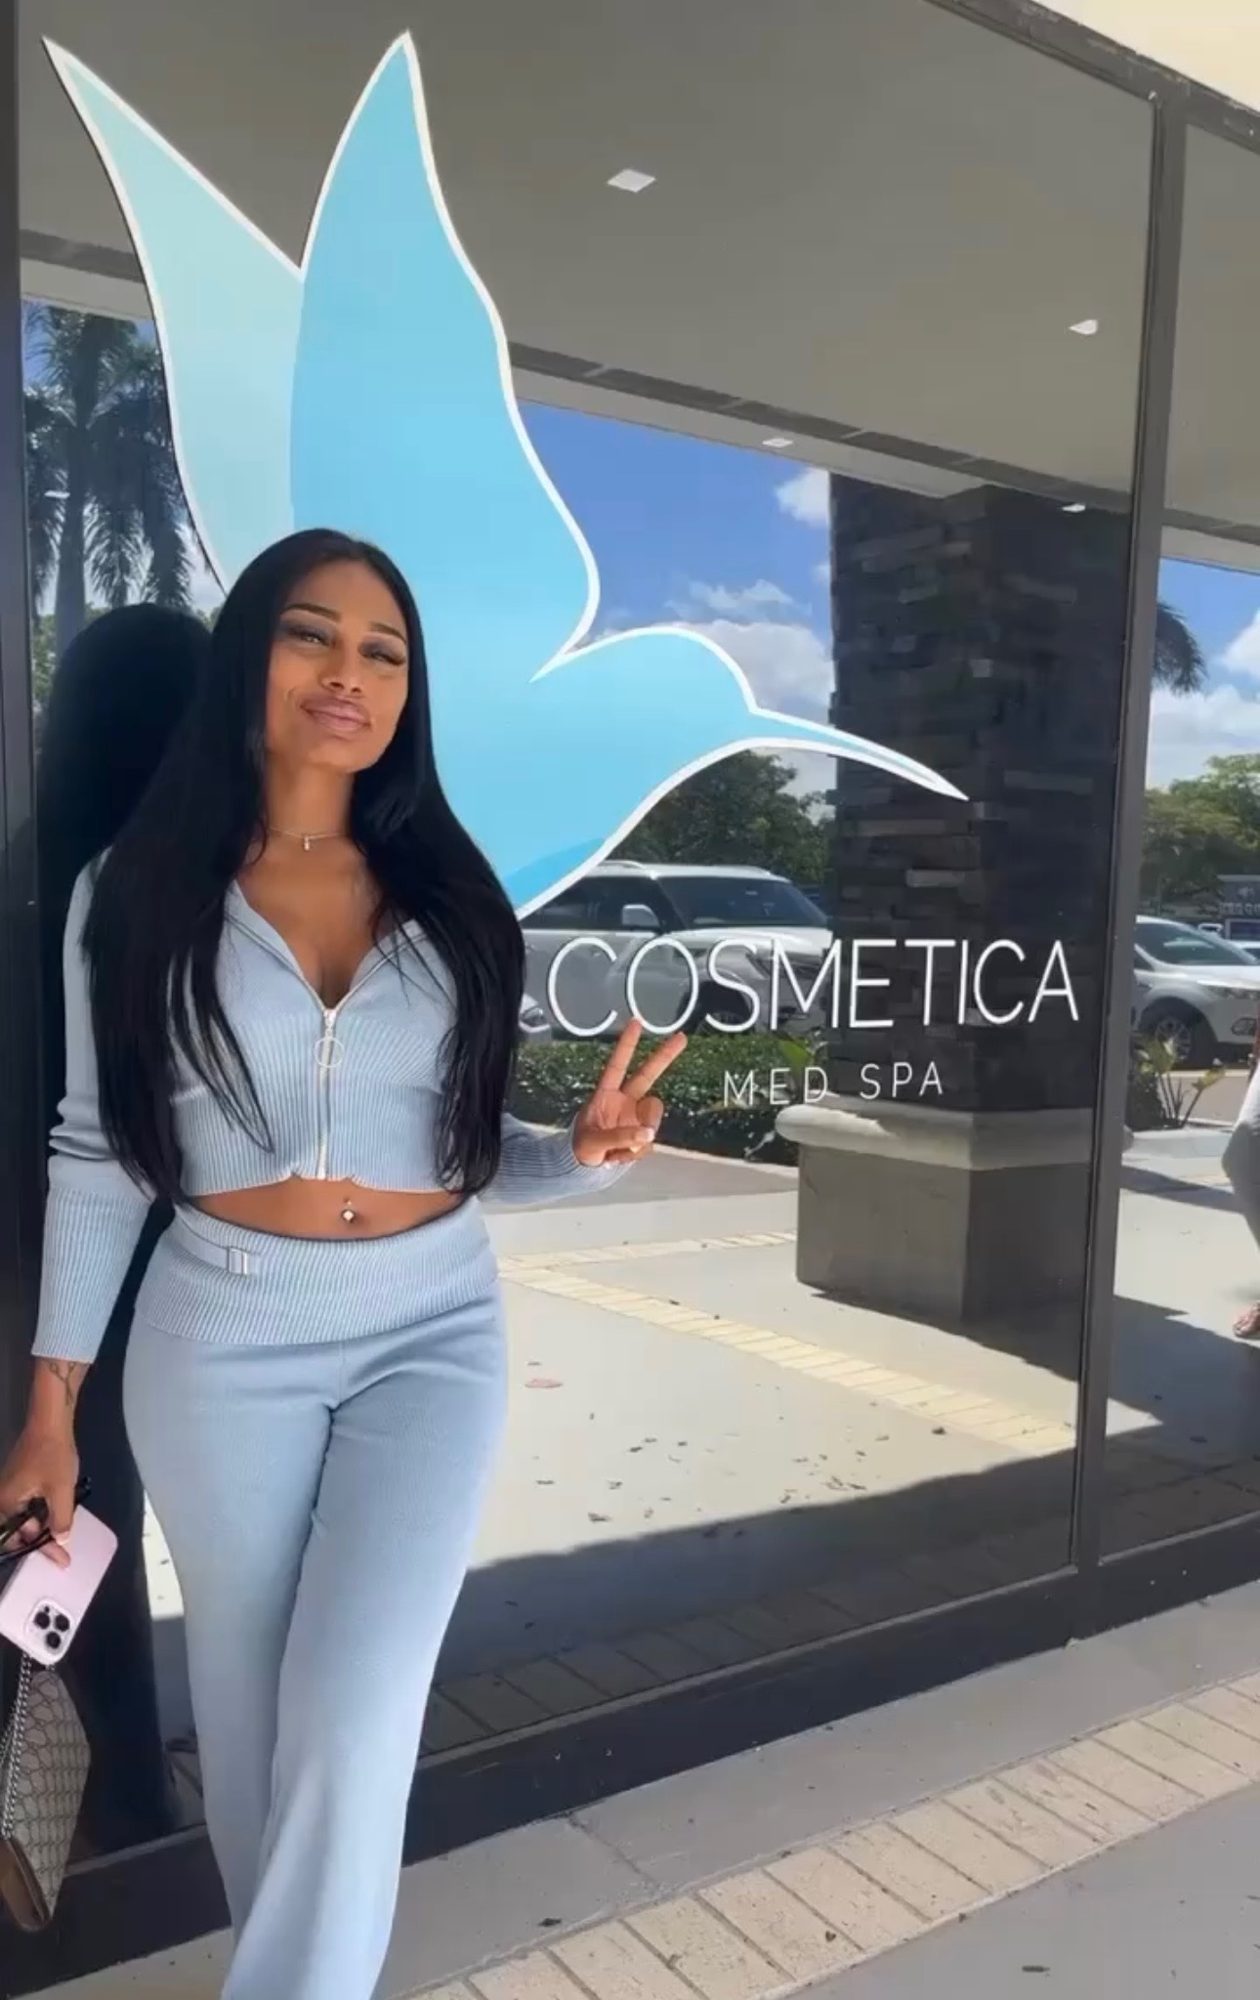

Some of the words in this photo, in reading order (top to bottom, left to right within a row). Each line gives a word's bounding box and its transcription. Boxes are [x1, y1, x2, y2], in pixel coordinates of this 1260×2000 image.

[547, 936, 1079, 1036] COSMETICA
[723, 1067, 829, 1106] MED
[859, 1060, 944, 1100] SPA
